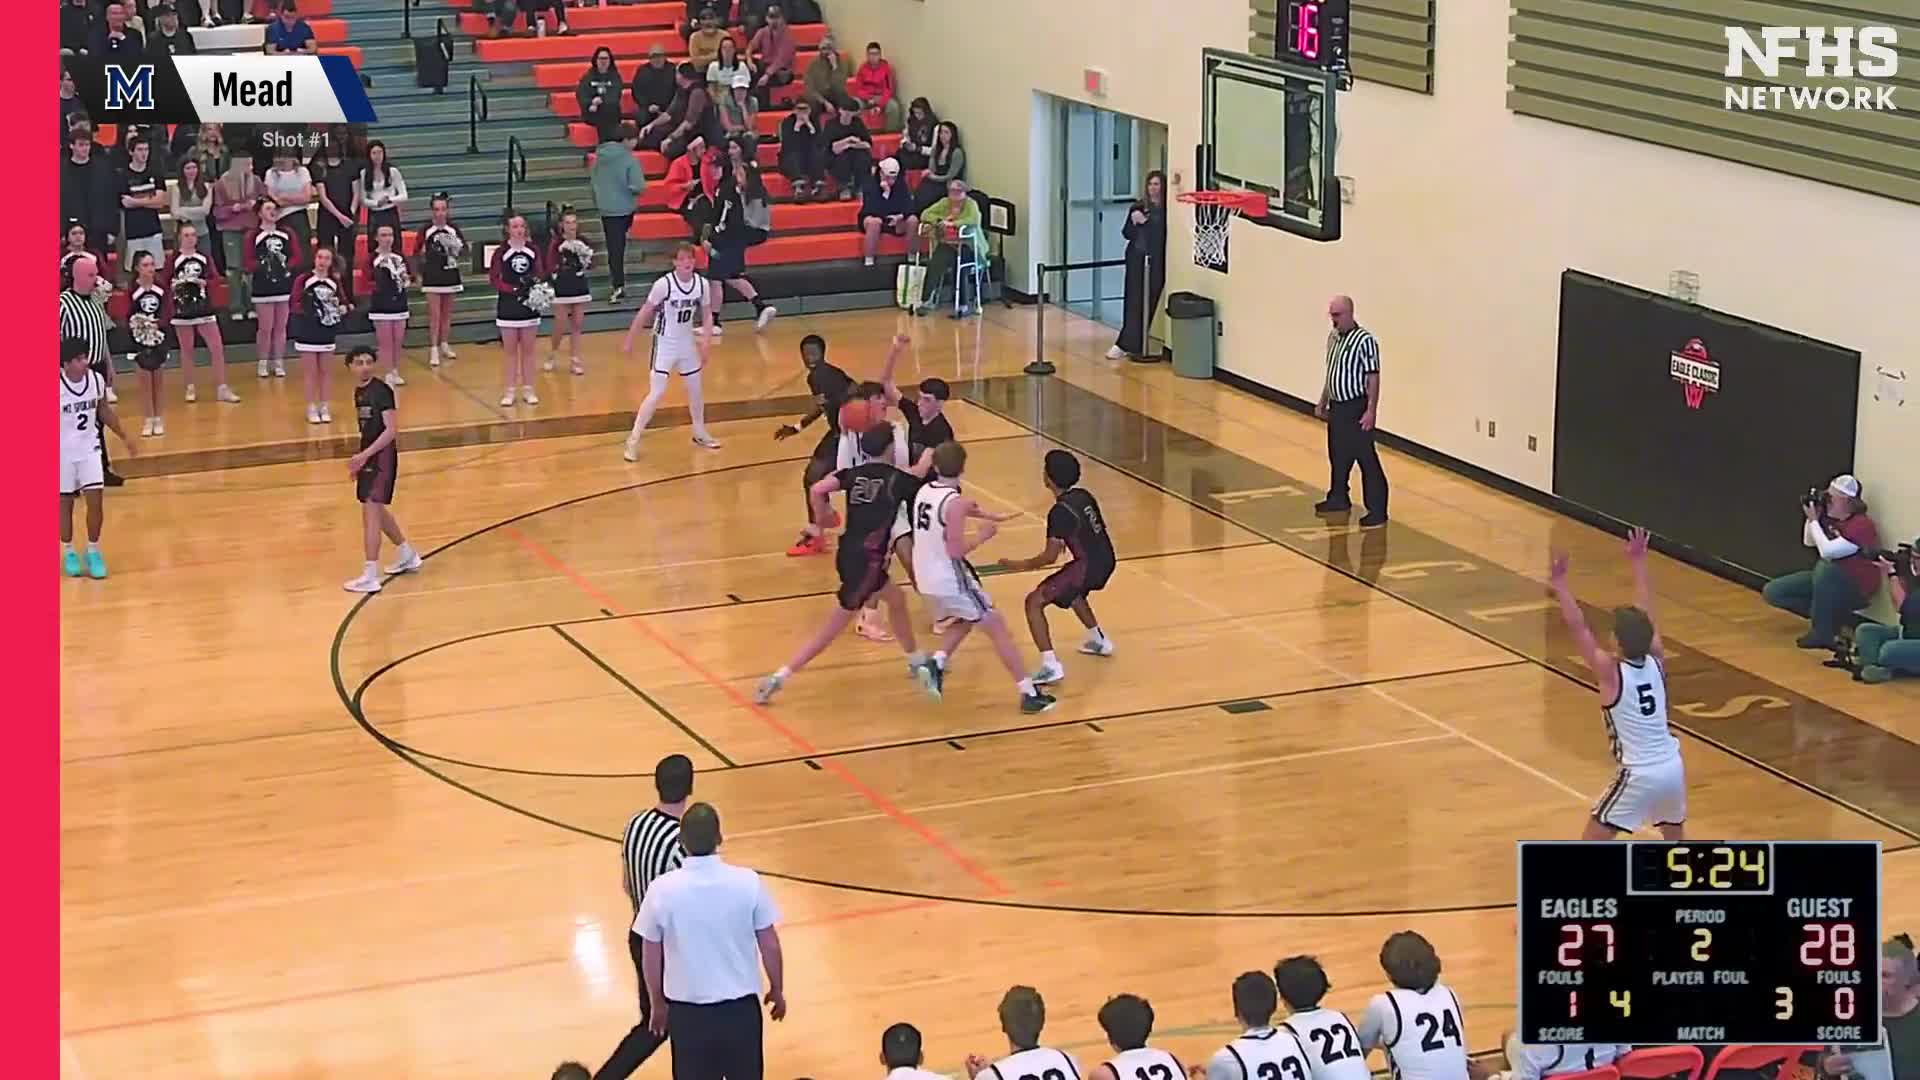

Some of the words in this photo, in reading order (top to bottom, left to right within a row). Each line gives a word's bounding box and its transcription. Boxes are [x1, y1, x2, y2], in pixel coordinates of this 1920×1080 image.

[676, 309, 692, 324] 10
[76, 413, 89, 431] 2
[916, 501, 933, 532] 15
[1635, 682, 1657, 716] 5
[1309, 1022, 1361, 1065] 22
[1415, 1008, 1463, 1053] 24
